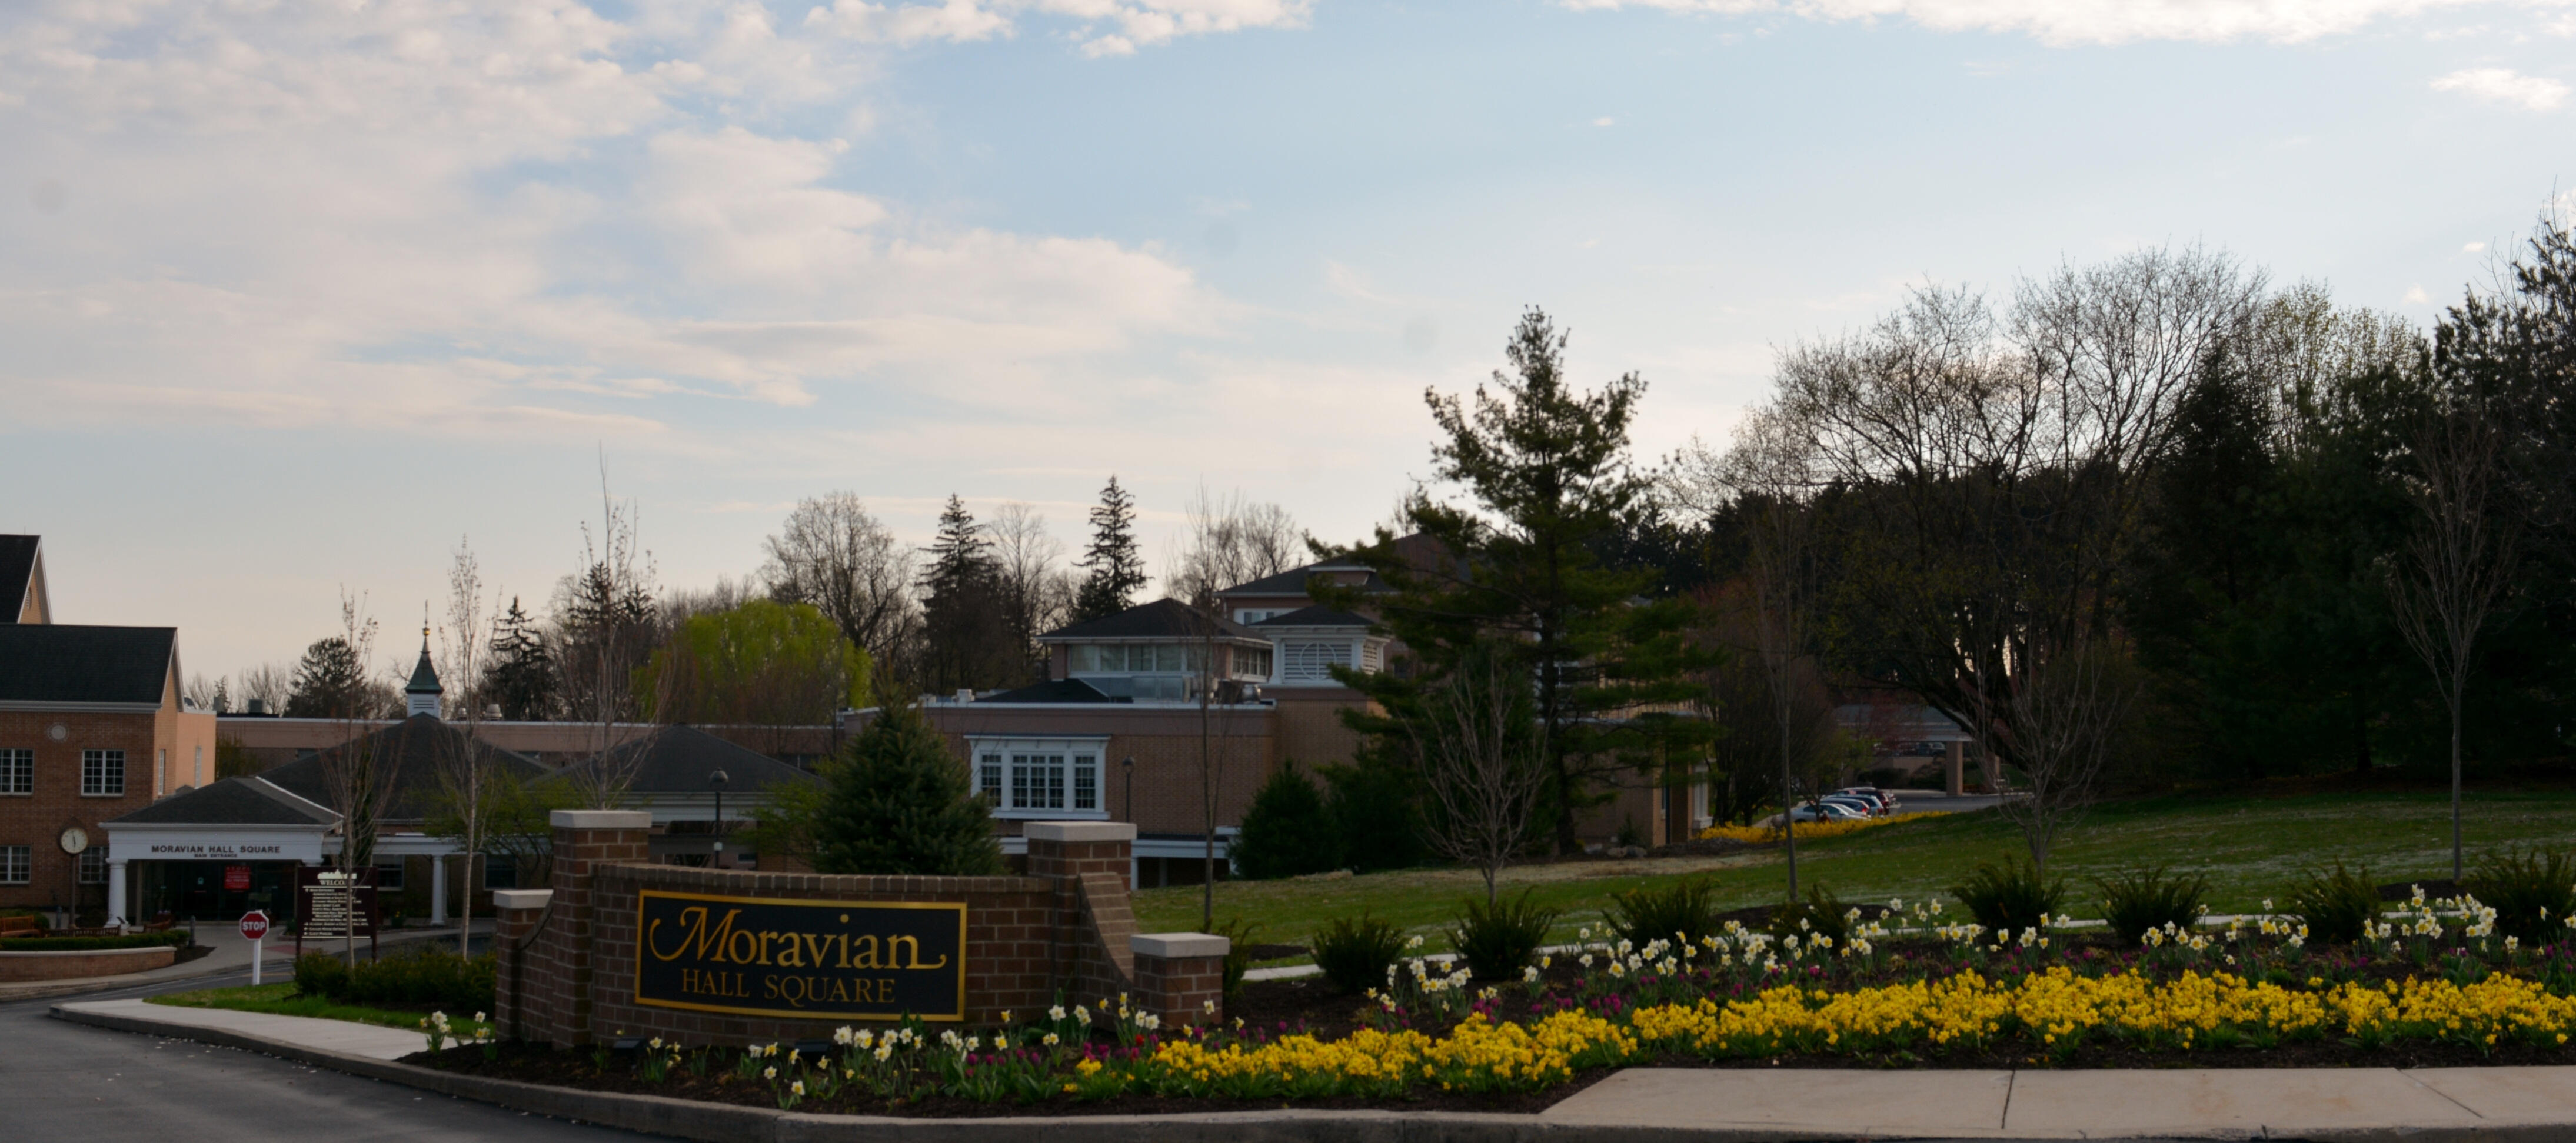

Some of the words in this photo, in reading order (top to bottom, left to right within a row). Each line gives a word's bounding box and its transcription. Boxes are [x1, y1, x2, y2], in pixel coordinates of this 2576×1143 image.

[242, 921, 265, 931] STOP
[649, 907, 947, 970] Moravian
[681, 968, 750, 998] HALL
[764, 974, 896, 1007] SQUARE
